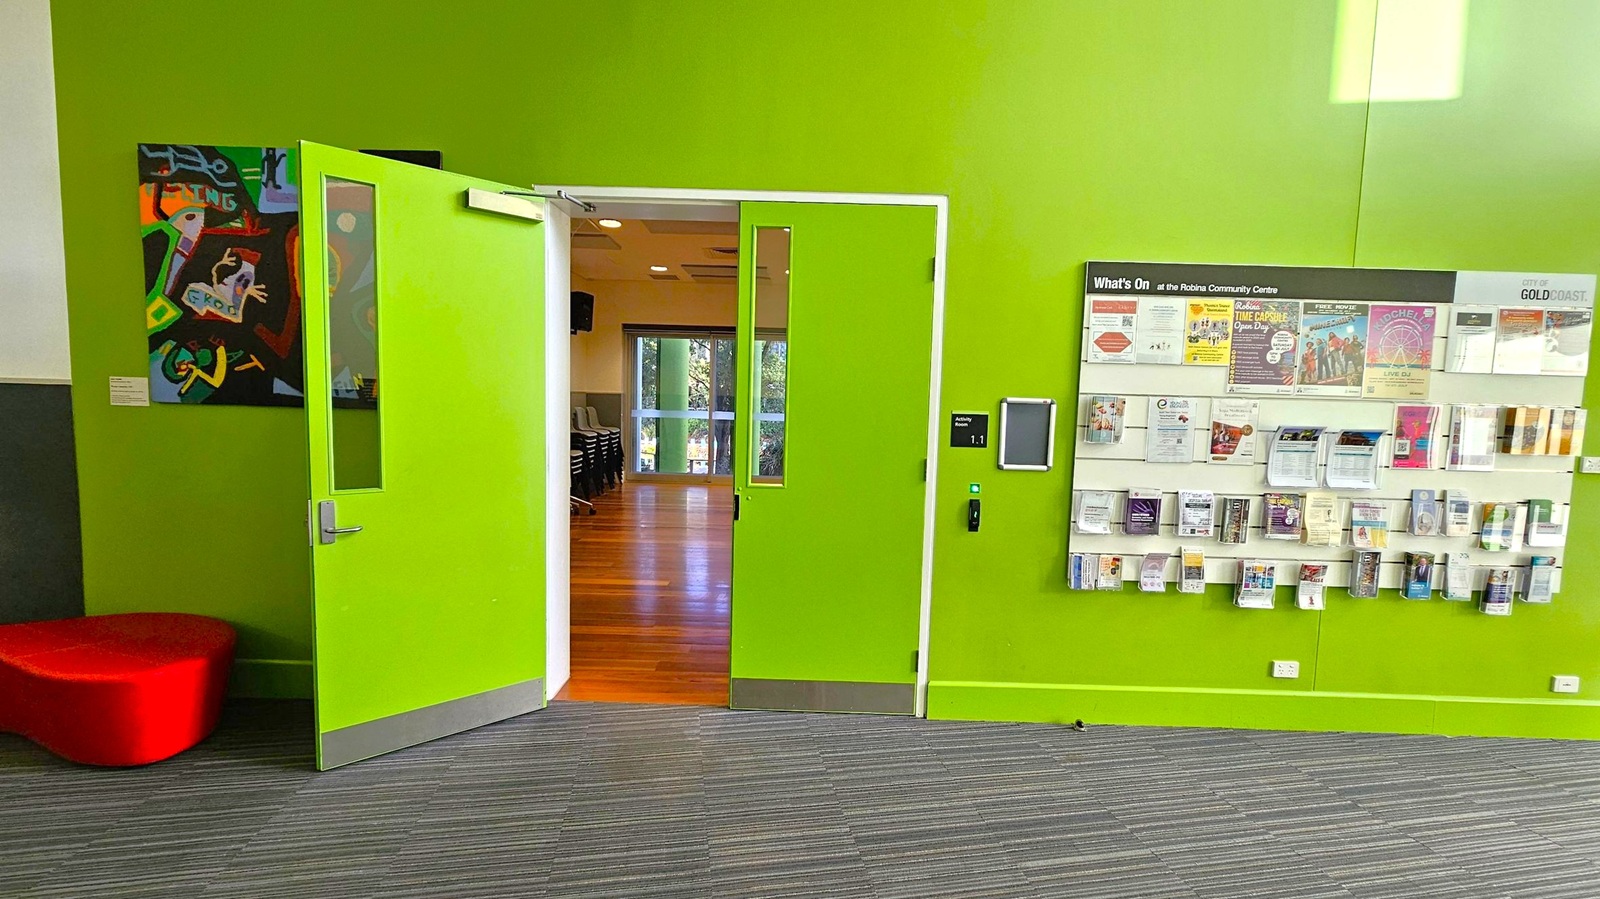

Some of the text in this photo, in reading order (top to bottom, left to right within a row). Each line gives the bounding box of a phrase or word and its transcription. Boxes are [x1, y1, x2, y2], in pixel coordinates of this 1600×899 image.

[1094, 276, 1278, 295] What's On at the Robina Community Centre
[1522, 279, 1549, 287] CITY OF
[1235, 301, 1261, 310] Robina
[1235, 311, 1288, 322] TIME CAPSULE
[1374, 309, 1431, 332] KIDCHELLA
[1234, 321, 1270, 334] Open Day
[970, 434, 984, 445] 1.1
